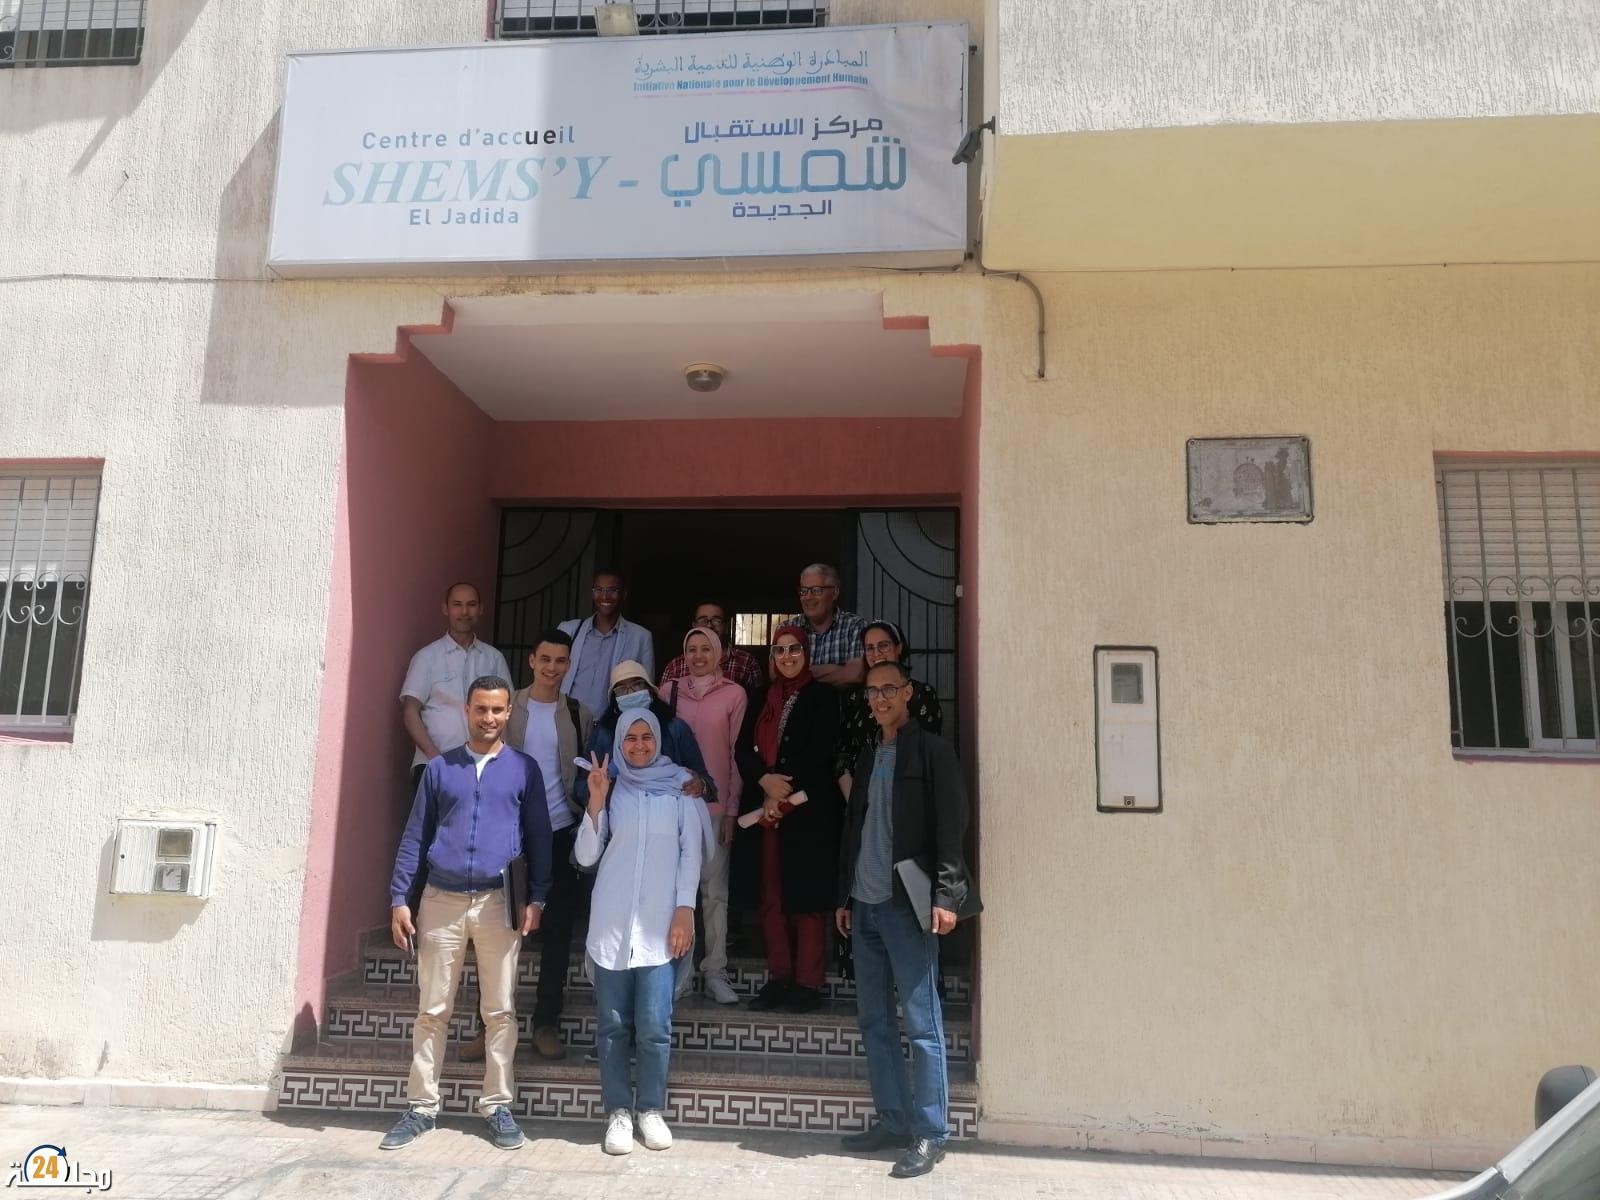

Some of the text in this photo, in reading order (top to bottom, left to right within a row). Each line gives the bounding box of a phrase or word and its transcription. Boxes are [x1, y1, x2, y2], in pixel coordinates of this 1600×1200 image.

[742, 50, 802, 76] الوطنية
[722, 77, 745, 89] pour
[832, 72, 869, 86] Humain
[361, 125, 576, 150] Centre d'accueil
[684, 114, 884, 144] مركز الاستقبال
[322, 155, 614, 207] SHEMS'Y
[660, 135, 907, 208] شمسي
[409, 207, 520, 226] El Jadida
[732, 199, 832, 221] الجديدة
